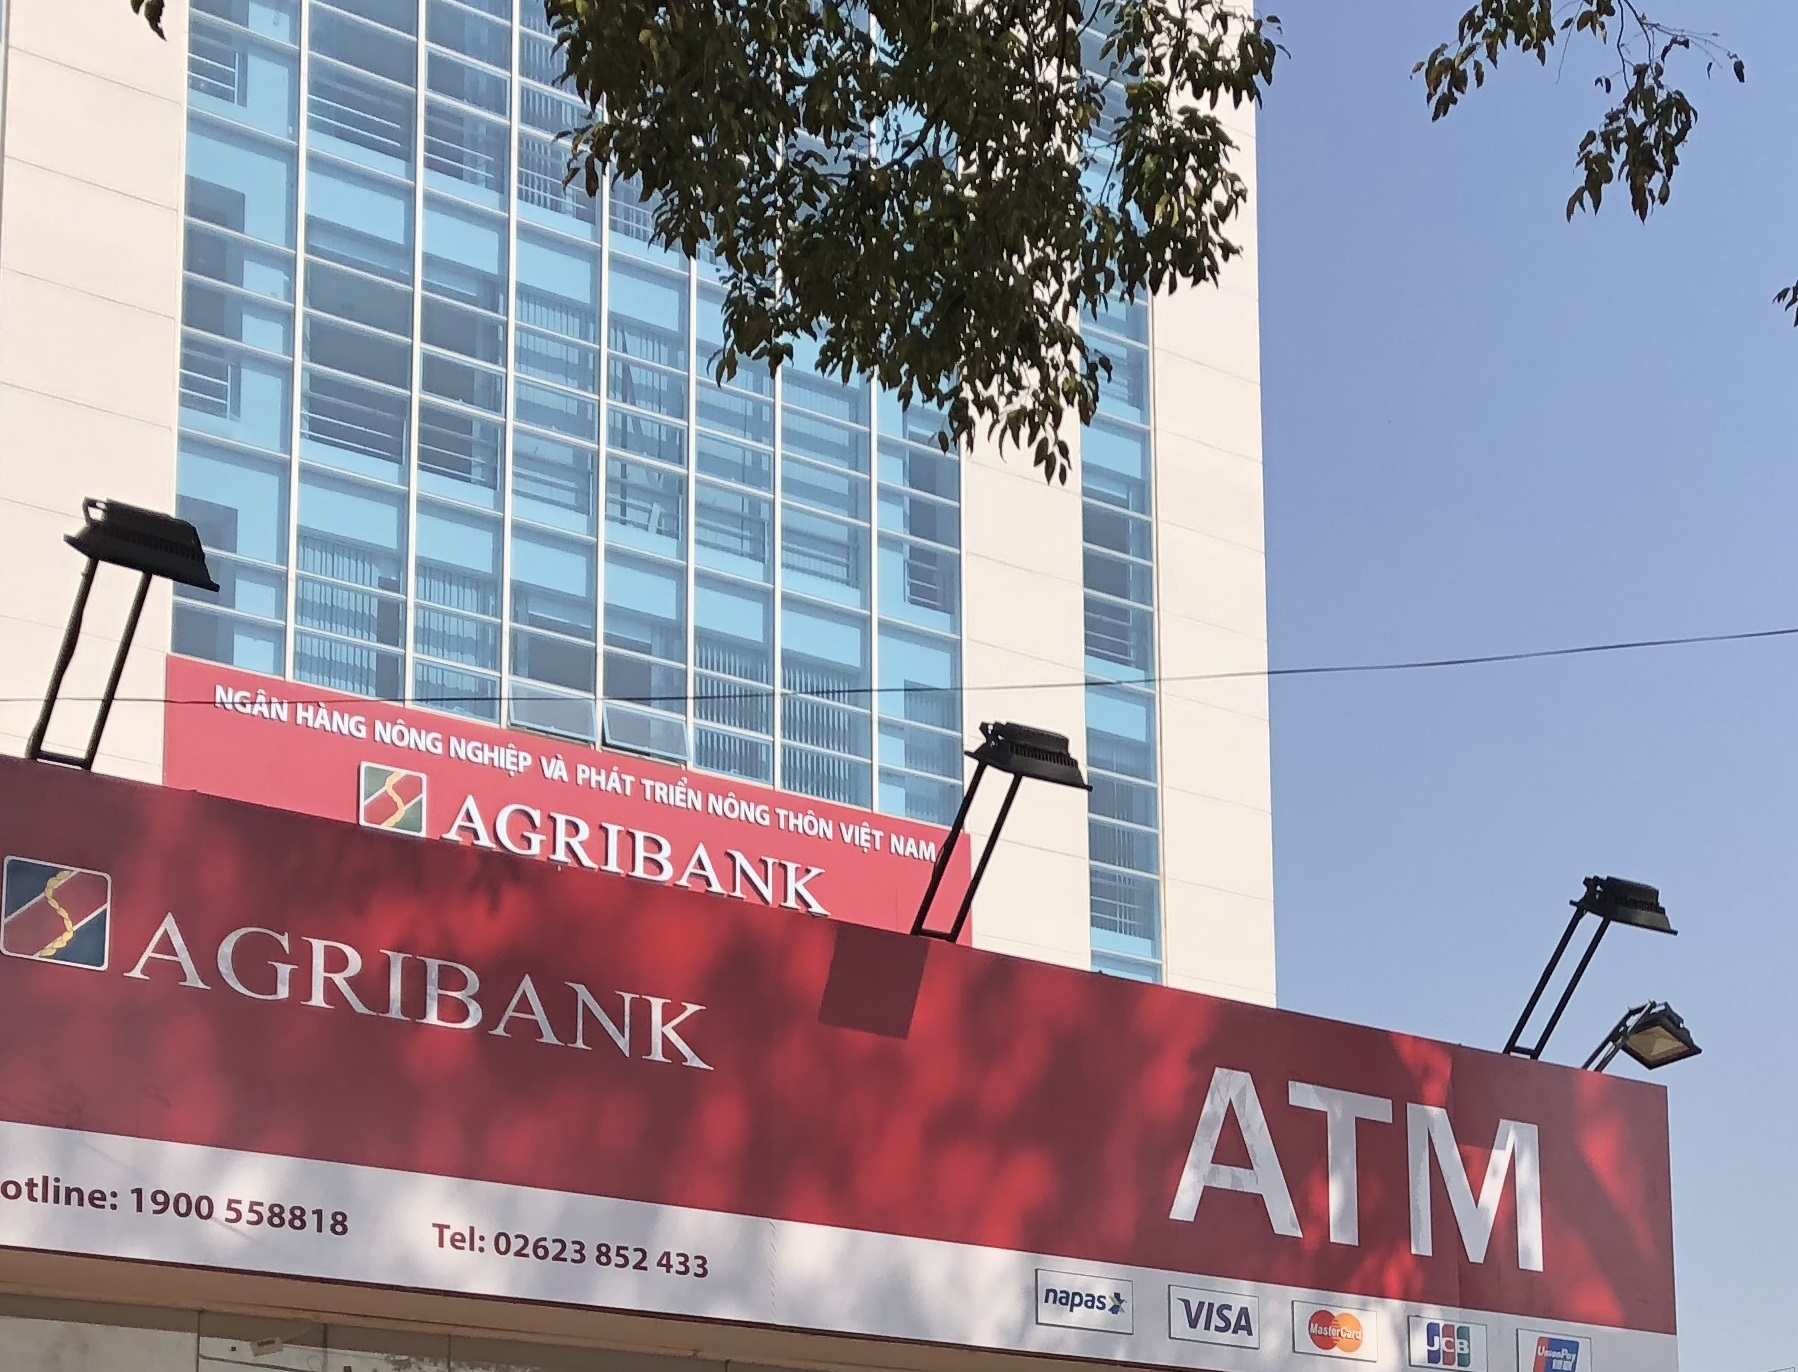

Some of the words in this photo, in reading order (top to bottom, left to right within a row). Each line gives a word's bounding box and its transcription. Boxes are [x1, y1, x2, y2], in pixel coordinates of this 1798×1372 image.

[214, 684, 288, 722] NGÂN
[295, 701, 366, 739] HÀNG
[374, 718, 443, 755] NÔNG
[449, 735, 532, 777] NGHIỆP
[540, 753, 569, 783] VÀ
[576, 765, 635, 797] PHÁT
[640, 776, 702, 811] TRIỂN
[707, 792, 771, 826] NÔNG
[775, 807, 834, 842] THÔN
[839, 821, 884, 853] VIỆT
[889, 833, 937, 863] NAM
[441, 794, 832, 917] AGRIBANK
[122, 911, 715, 1071] AGRIBANK
[1168, 1066, 1544, 1272] ATM
[129, 1186, 215, 1222] 1900
[224, 1198, 349, 1237] 558818
[432, 1222, 486, 1254] Tel:
[494, 1231, 587, 1266] 02623
[595, 1243, 648, 1273] 852
[655, 1250, 710, 1279] 433
[1044, 1287, 1107, 1313] napas
[1177, 1297, 1254, 1337] VISA
[1309, 1321, 1363, 1341] MasterCard
[1427, 1335, 1470, 1355] JCB
